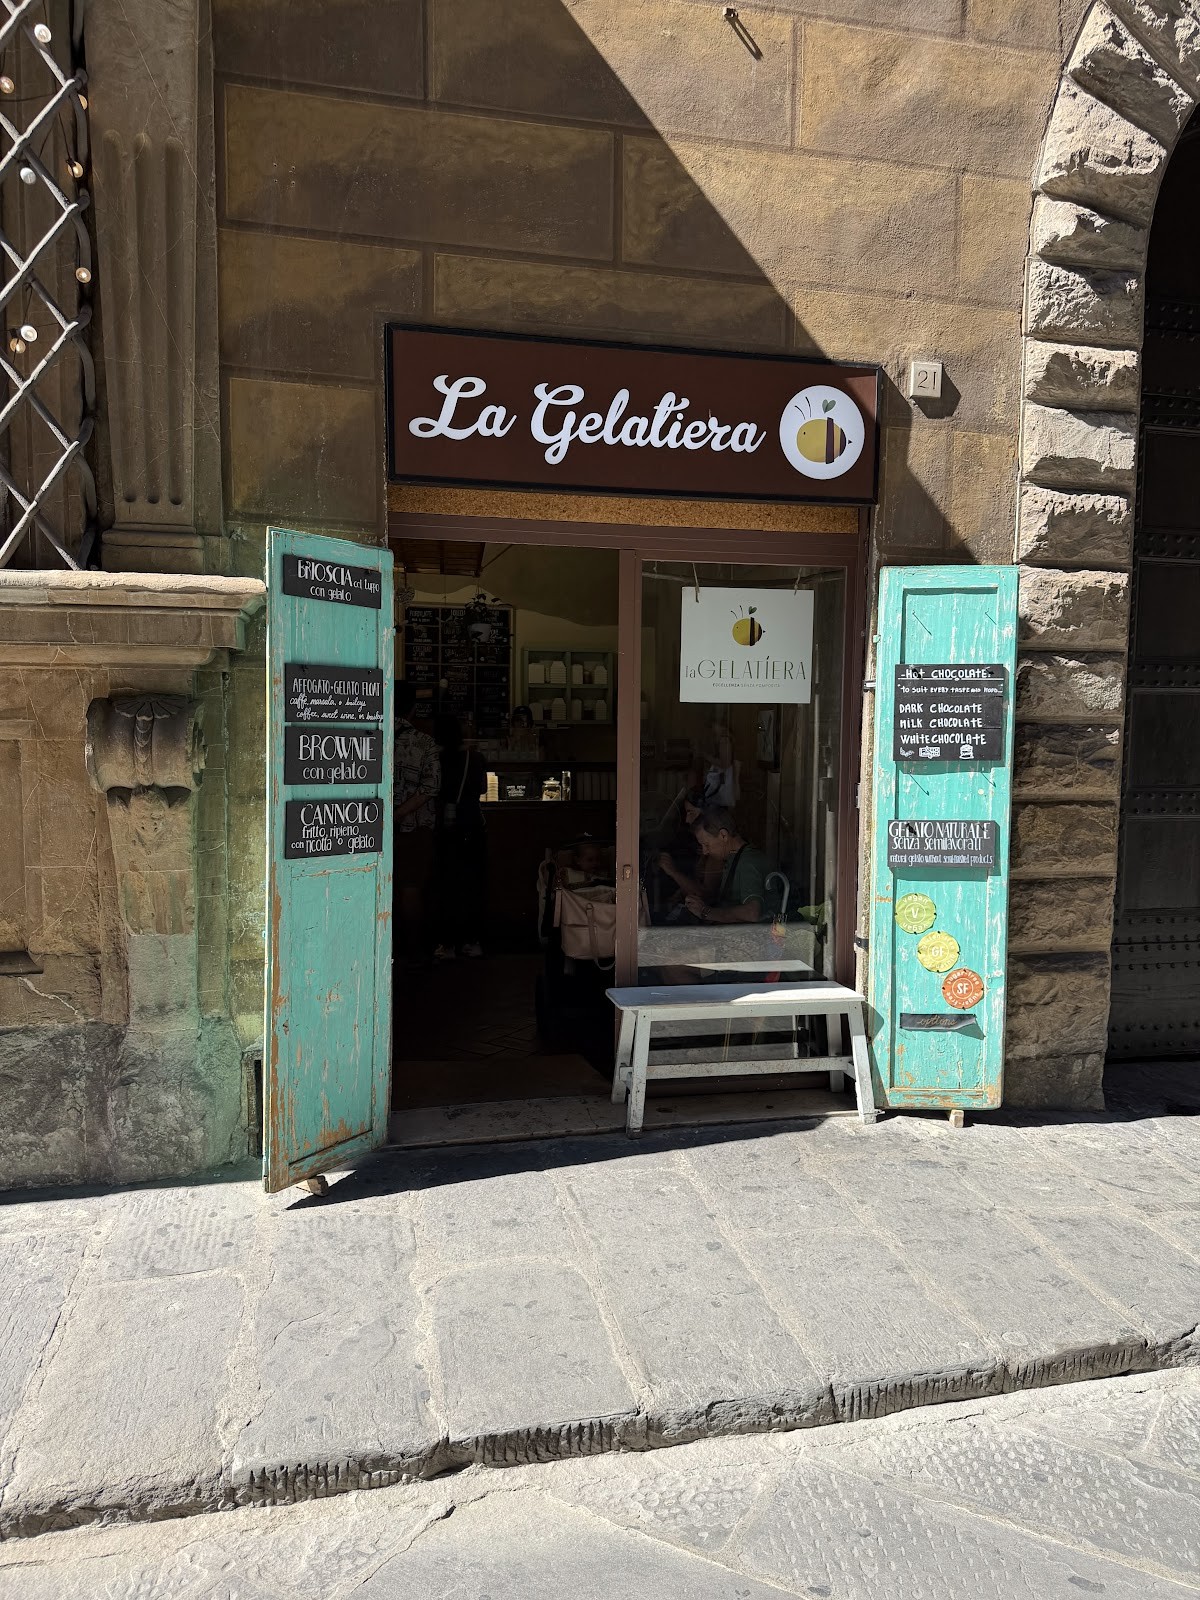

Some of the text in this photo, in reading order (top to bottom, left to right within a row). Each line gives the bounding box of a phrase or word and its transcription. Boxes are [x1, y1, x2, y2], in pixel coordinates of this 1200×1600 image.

[917, 369, 937, 390] 21
[409, 374, 767, 465] La Gelatiera
[297, 559, 353, 587] BRIOSCIA
[310, 585, 352, 602] con gelato
[362, 681, 381, 697] FLOAT
[899, 703, 983, 714] DARK CHOCOLATE
[929, 717, 983, 729] CHOCOLATE
[298, 734, 377, 761] BROWNIE
[302, 761, 368, 784] con gelato
[300, 802, 379, 826] CANNOLO
[329, 825, 360, 840] ripieno
[888, 821, 991, 839] GELATO NATURALE
[291, 834, 375, 854] con ricotta o gelato
[892, 836, 920, 850] senza
[908, 853, 925, 867] gelato
[970, 853, 993, 867] products
[902, 895, 929, 905] vegan
[911, 907, 920, 919] V
[931, 945, 946, 958] GF
[946, 971, 980, 985] sugar-free
[956, 982, 970, 995] SF
